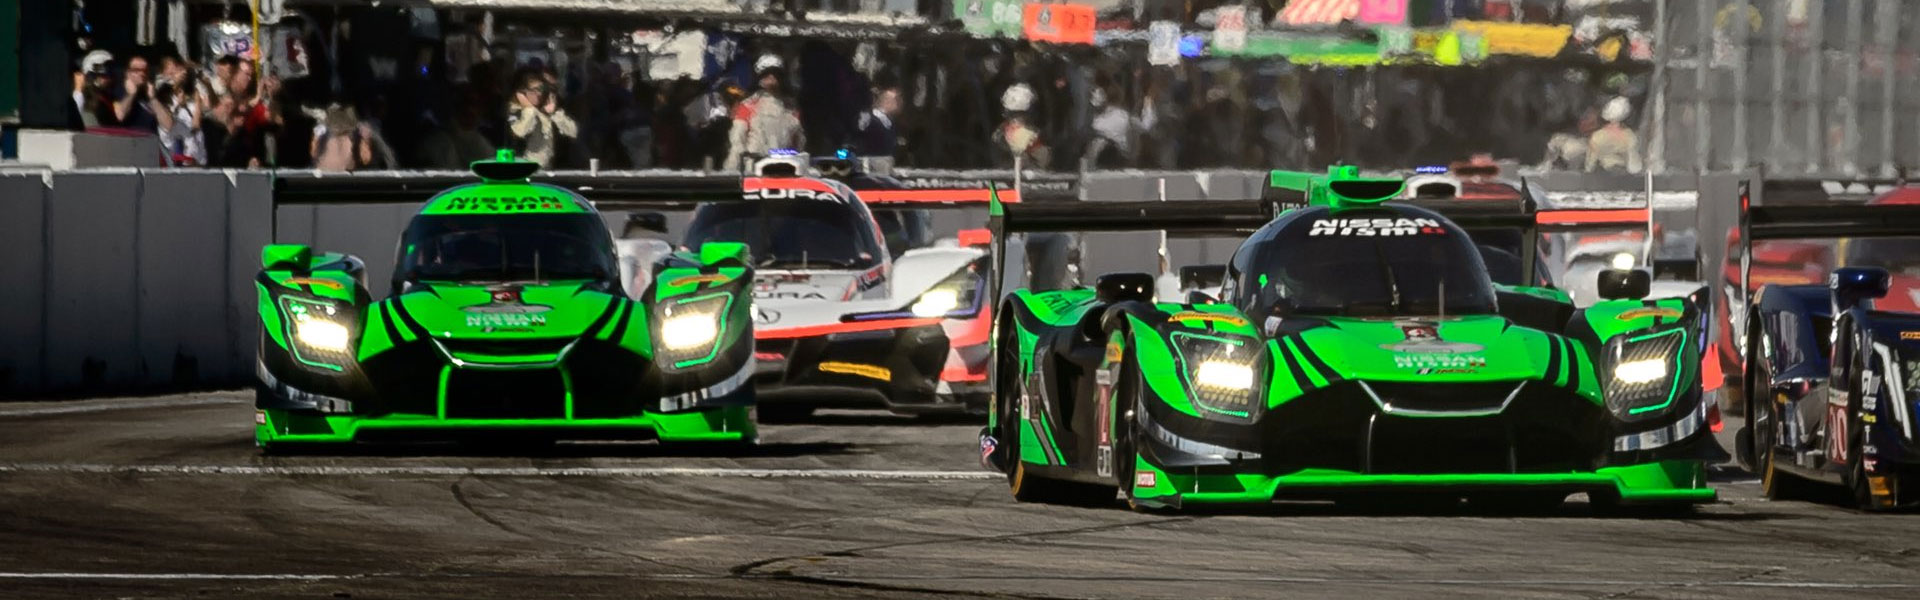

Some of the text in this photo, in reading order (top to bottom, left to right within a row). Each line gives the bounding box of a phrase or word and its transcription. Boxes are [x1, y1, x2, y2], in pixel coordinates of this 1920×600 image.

[743, 188, 842, 204] CURA
[1312, 218, 1440, 228] NISSAN
[1394, 355, 1486, 364] NISSAN
